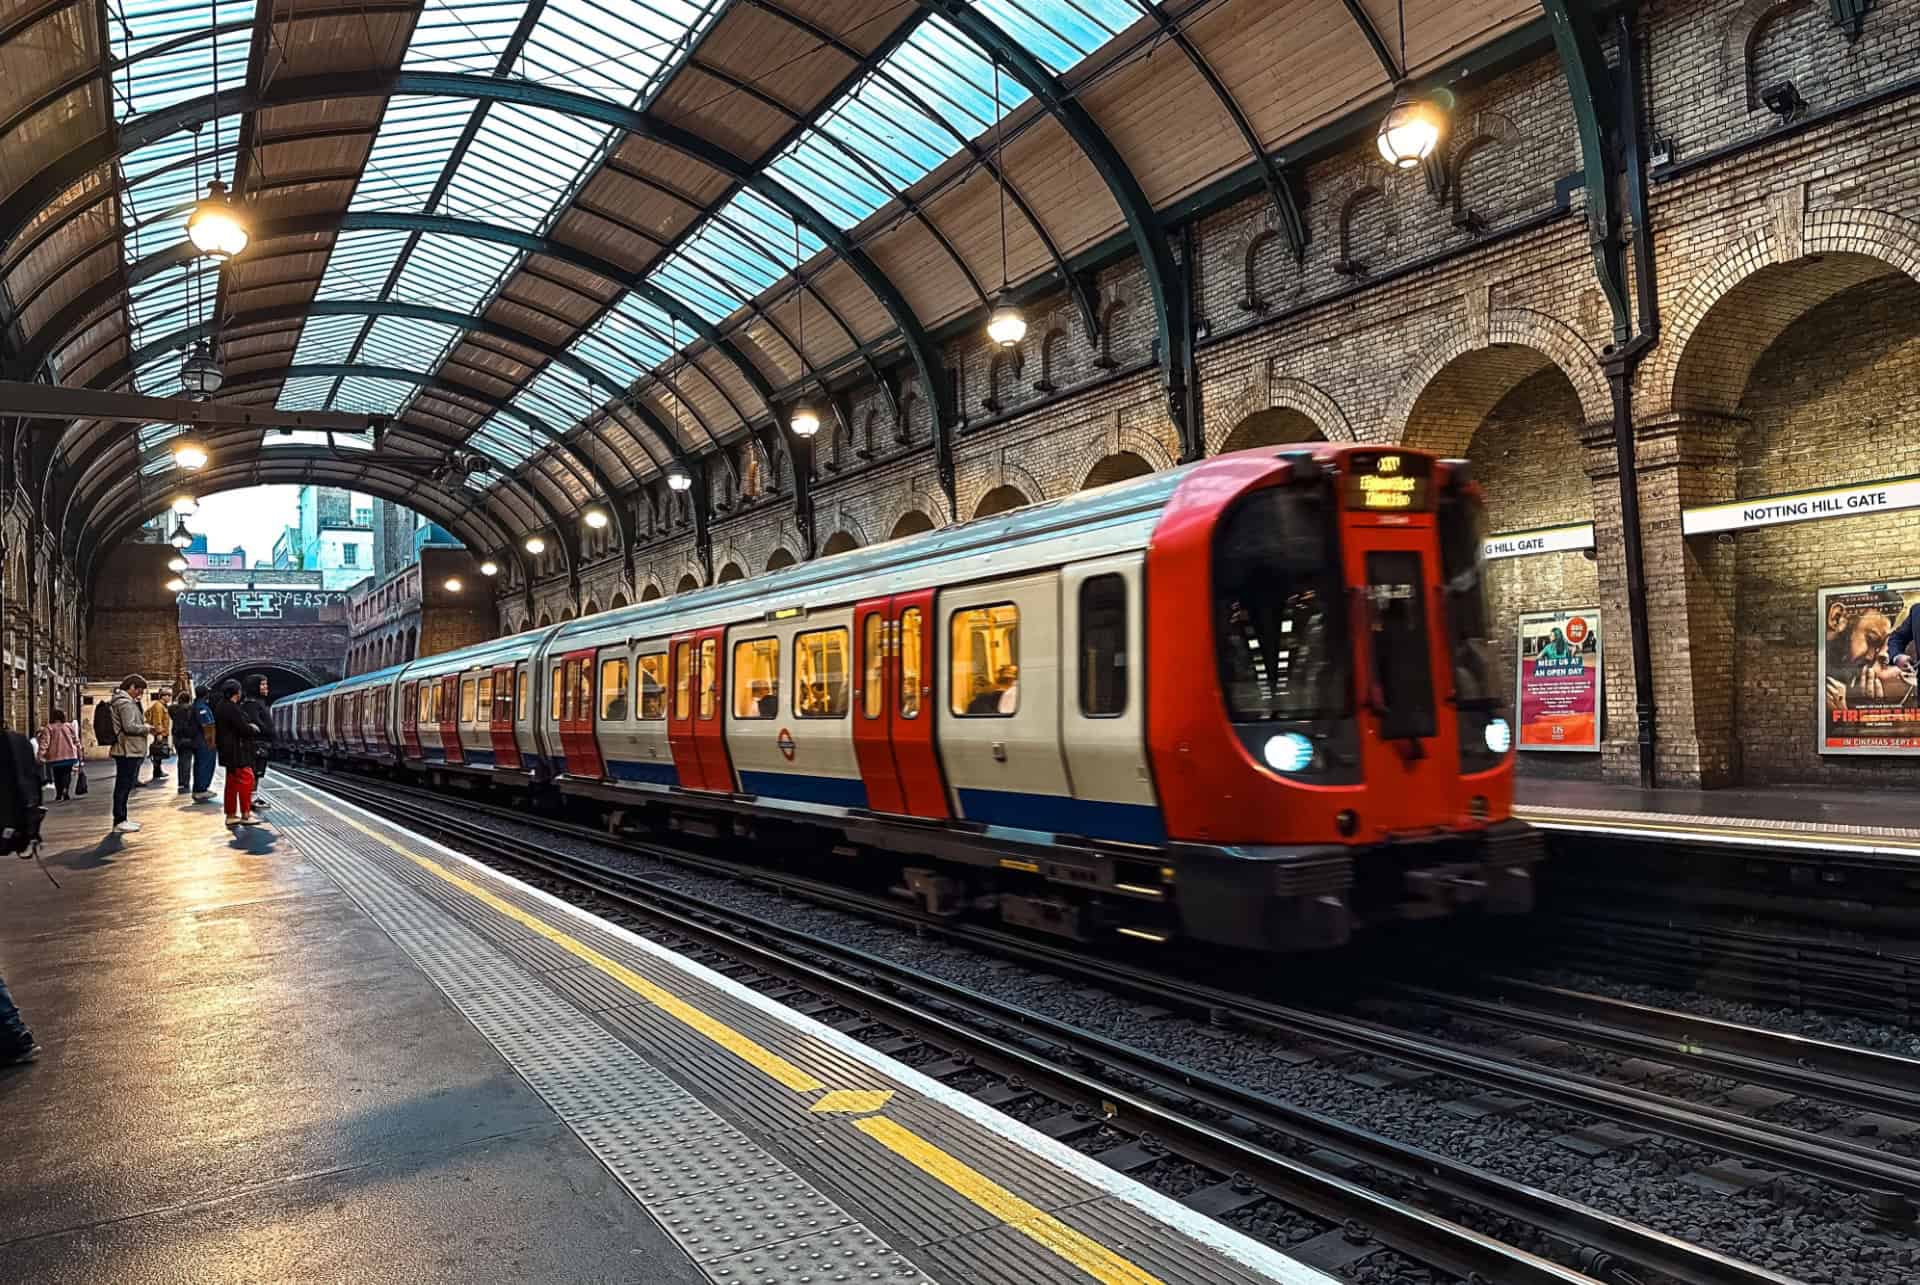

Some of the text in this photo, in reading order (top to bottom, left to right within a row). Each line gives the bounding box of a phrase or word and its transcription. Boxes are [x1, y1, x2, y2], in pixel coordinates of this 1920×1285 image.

[1743, 492, 1886, 521] NOTTING HILL GATE
[1494, 541, 1516, 553] HILL
[1518, 538, 1544, 551] GATE
[1853, 737, 1889, 746] CINEMAS
